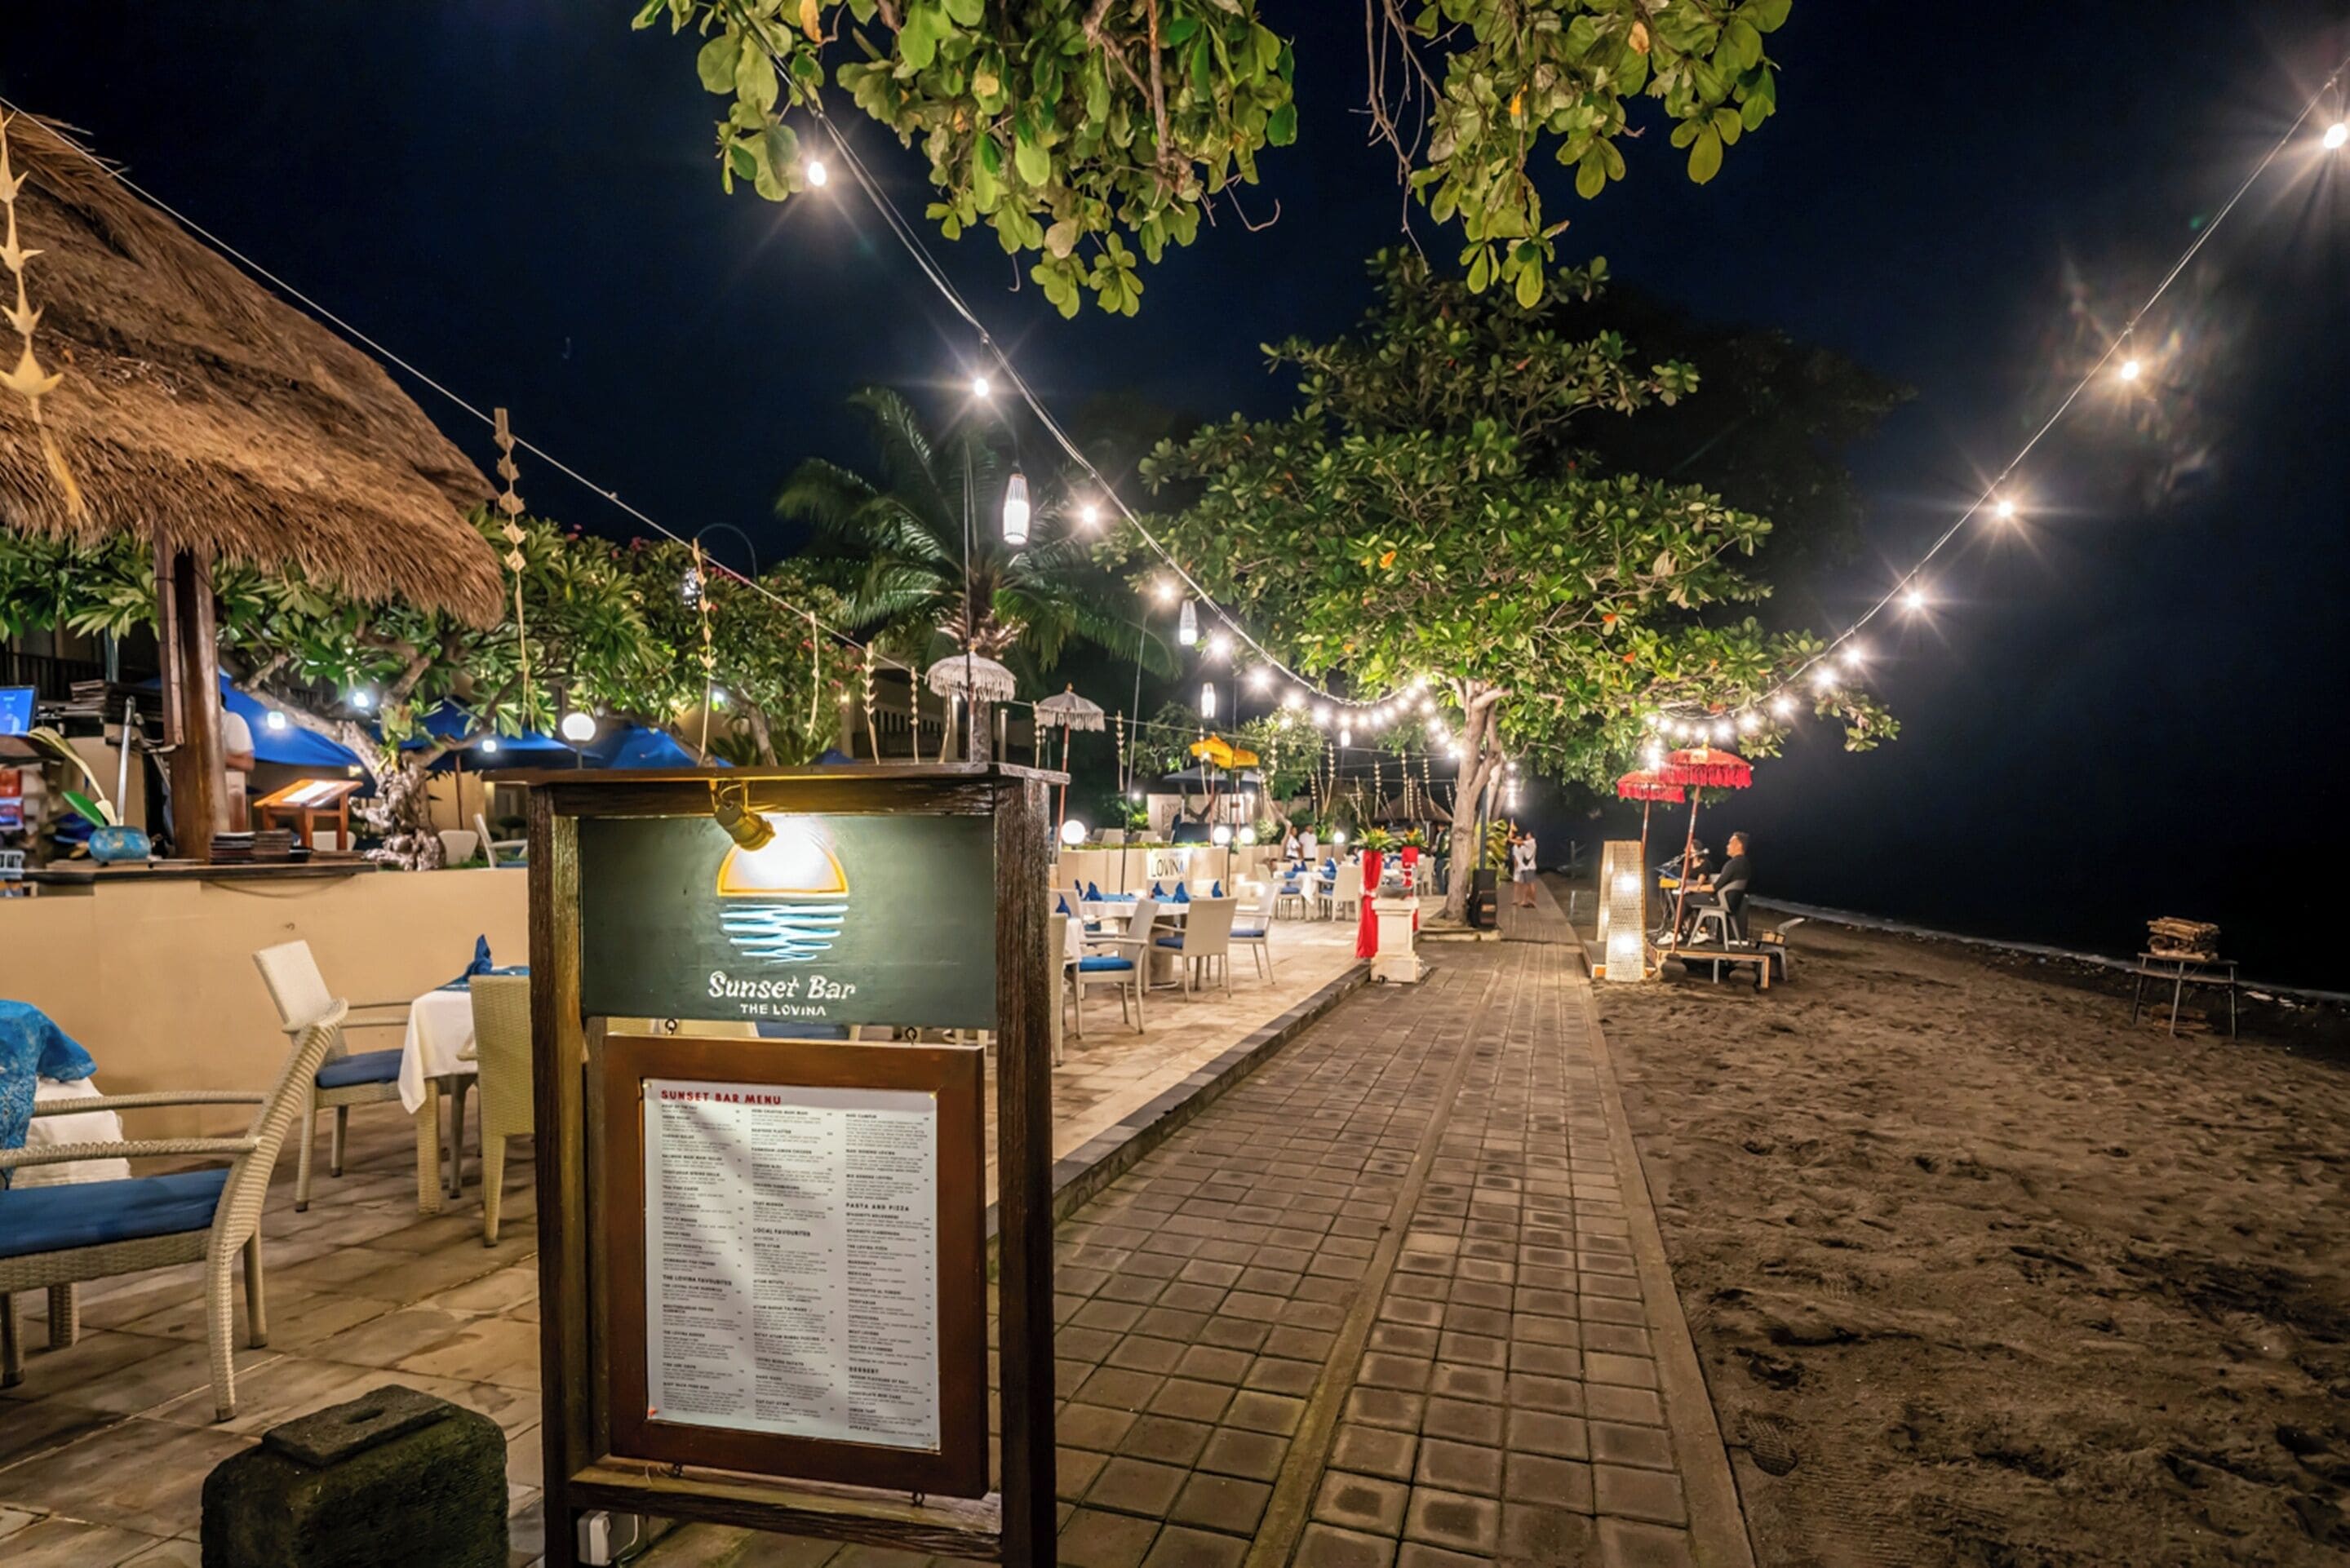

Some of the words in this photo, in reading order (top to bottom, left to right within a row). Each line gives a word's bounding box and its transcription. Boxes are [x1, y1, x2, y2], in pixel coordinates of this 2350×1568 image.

[708, 970, 800, 999] Sunset
[807, 974, 856, 999] Bar
[740, 1003, 769, 1014] THE
[773, 1004, 827, 1016] LOVINA
[661, 1089, 710, 1101] SUNSET
[715, 1092, 739, 1103] BAR
[745, 1094, 781, 1105] MENU
